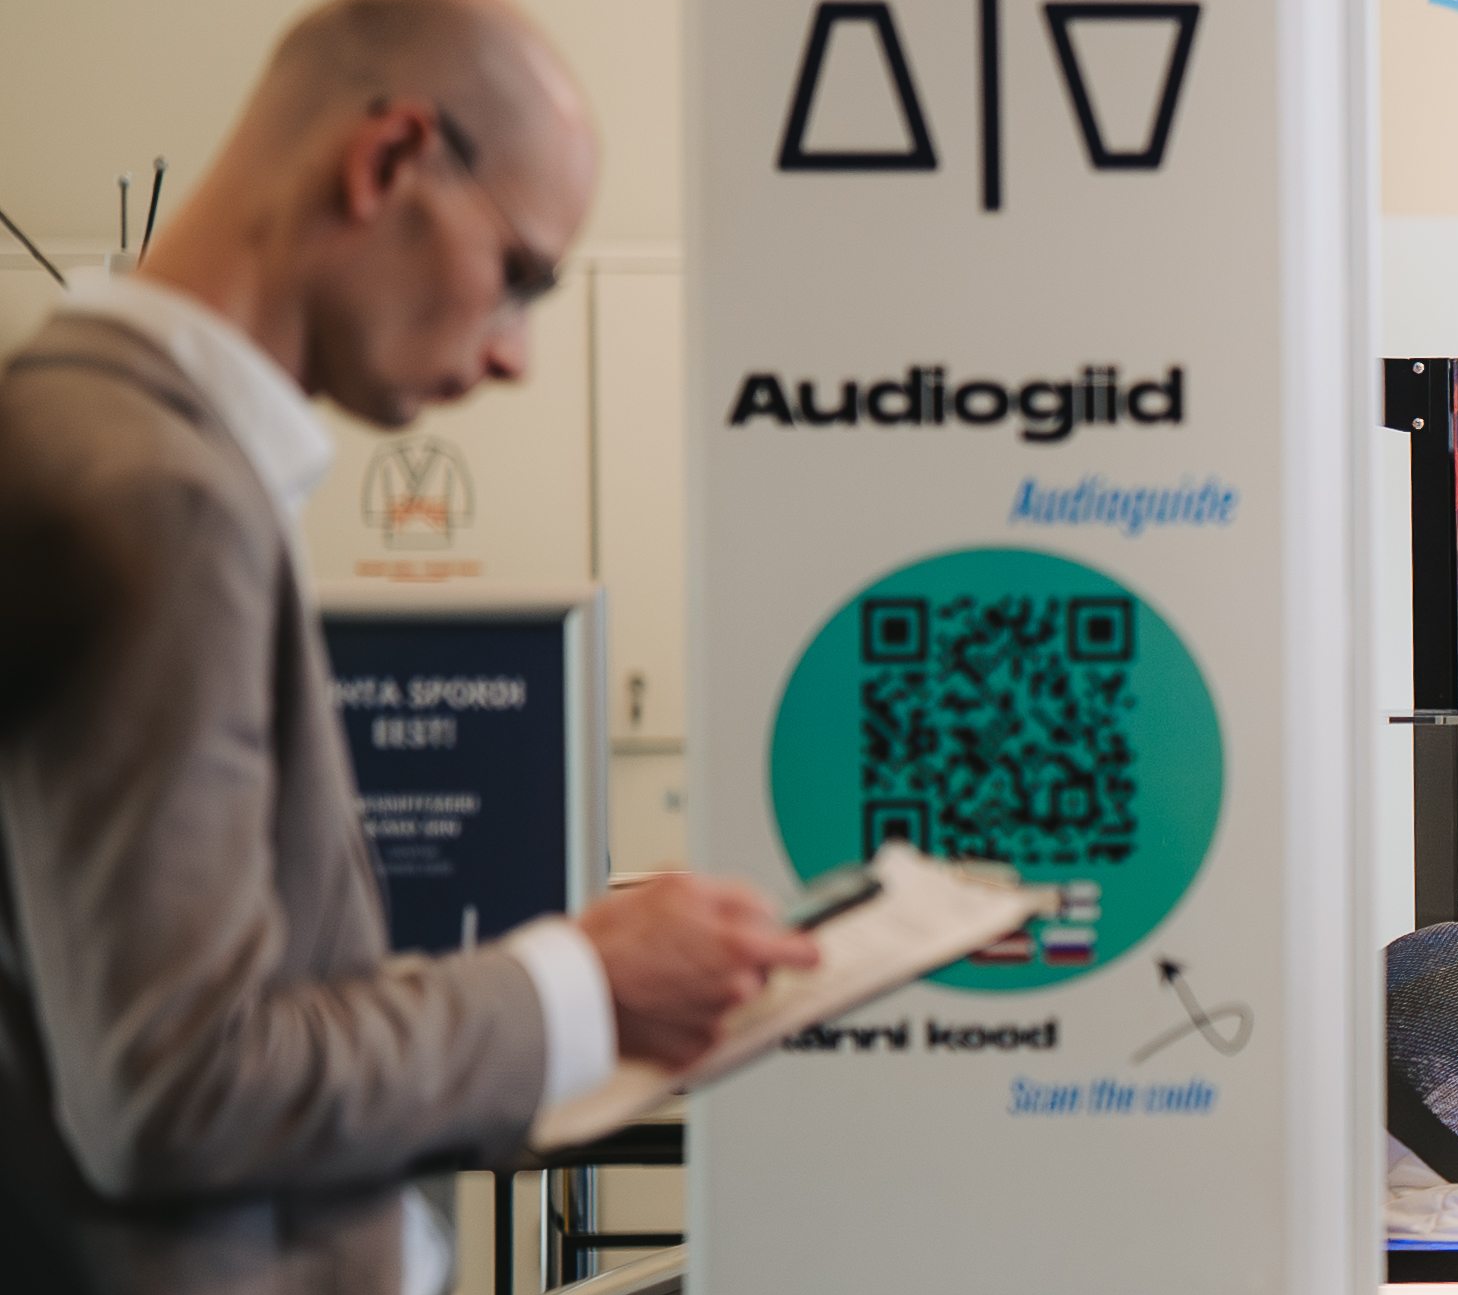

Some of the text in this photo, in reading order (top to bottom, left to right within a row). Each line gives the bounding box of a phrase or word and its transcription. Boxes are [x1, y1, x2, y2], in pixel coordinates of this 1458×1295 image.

[728, 367, 1186, 442] Audiogiid
[1006, 475, 1238, 538] Audioguide
[926, 1012, 1059, 1052] kood
